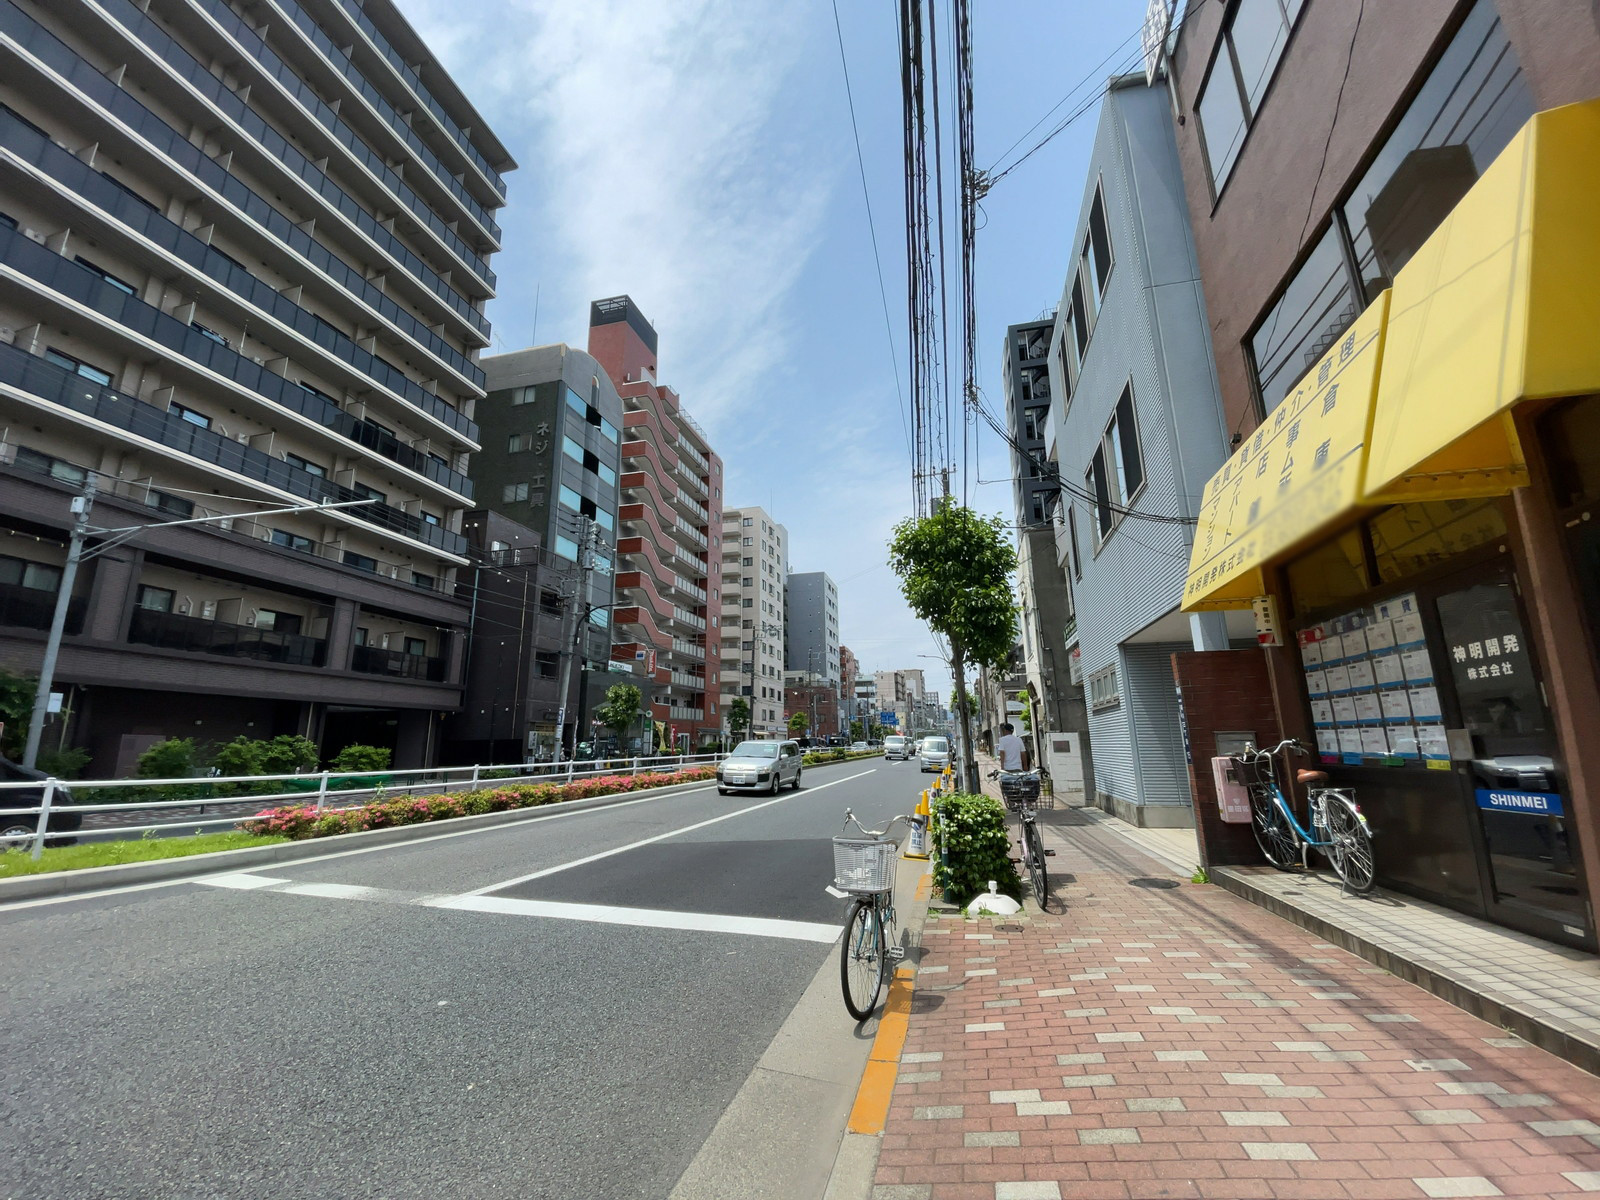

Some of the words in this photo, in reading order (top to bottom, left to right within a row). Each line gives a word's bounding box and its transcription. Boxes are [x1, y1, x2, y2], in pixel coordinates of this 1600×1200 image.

[1224, 475, 1243, 545] アパート
[1203, 496, 1221, 561] マンション
[1452, 634, 1520, 663] 神明開発
[1467, 662, 1514, 680] 株式会社
[1489, 793, 1548, 810] SHINMEI
